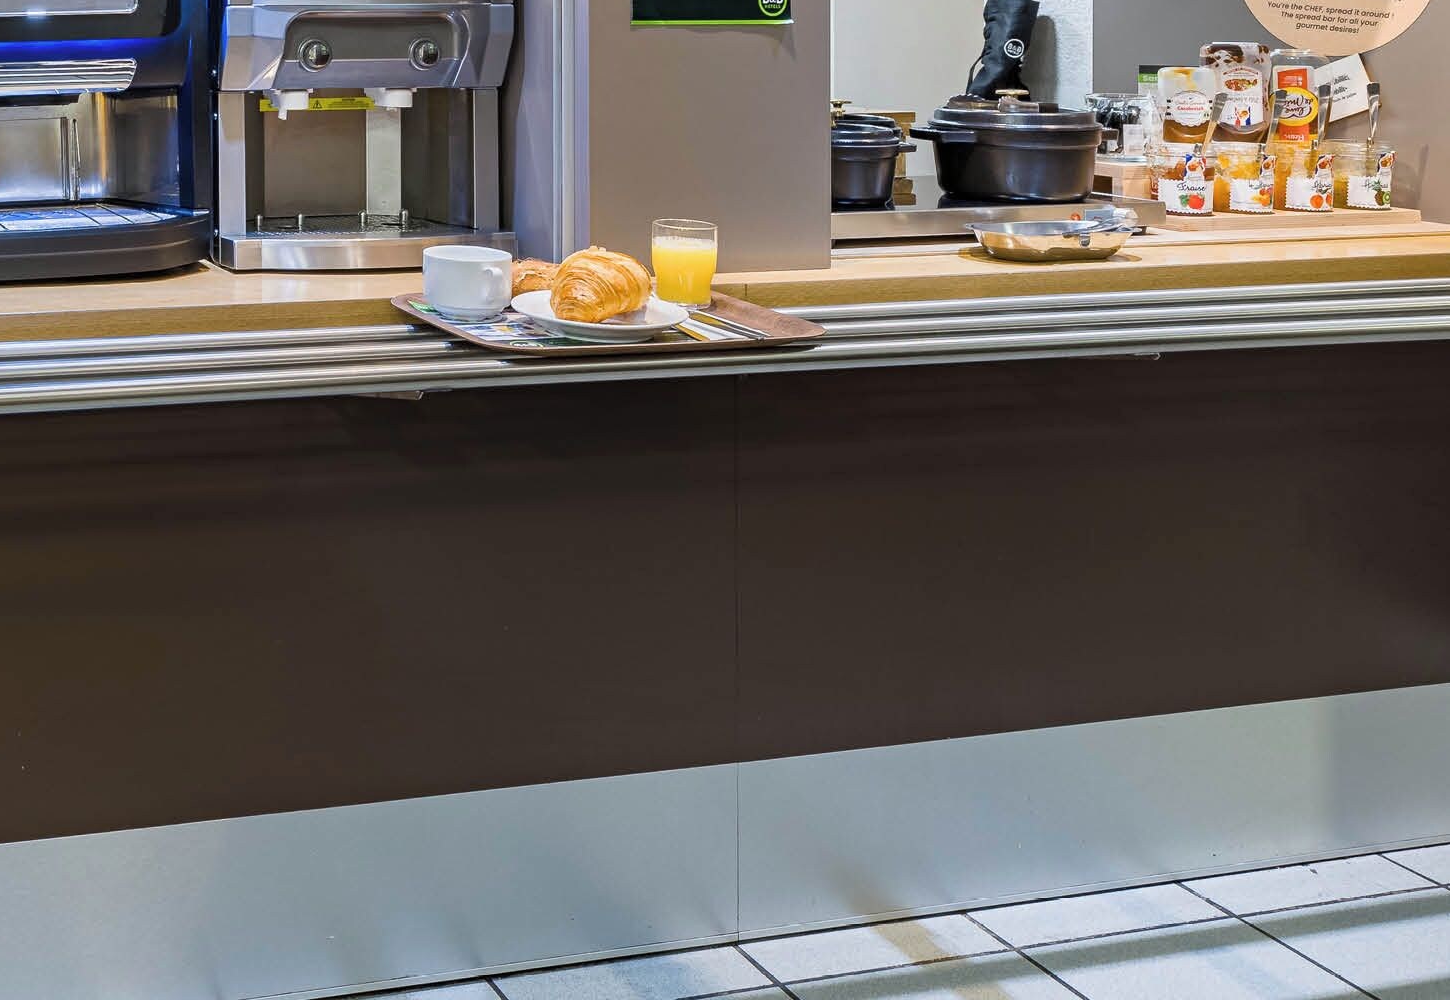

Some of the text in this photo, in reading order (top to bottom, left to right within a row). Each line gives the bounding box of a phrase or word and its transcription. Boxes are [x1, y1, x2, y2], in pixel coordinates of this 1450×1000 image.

[1291, 2, 1303, 10] the
[1304, 5, 1324, 13] CHEF,
[1325, 6, 1353, 16] spread
[1295, 12, 1321, 22] spread
[1322, 14, 1336, 22] bar
[1360, 19, 1378, 27] your
[1295, 22, 1328, 31] gourmet
